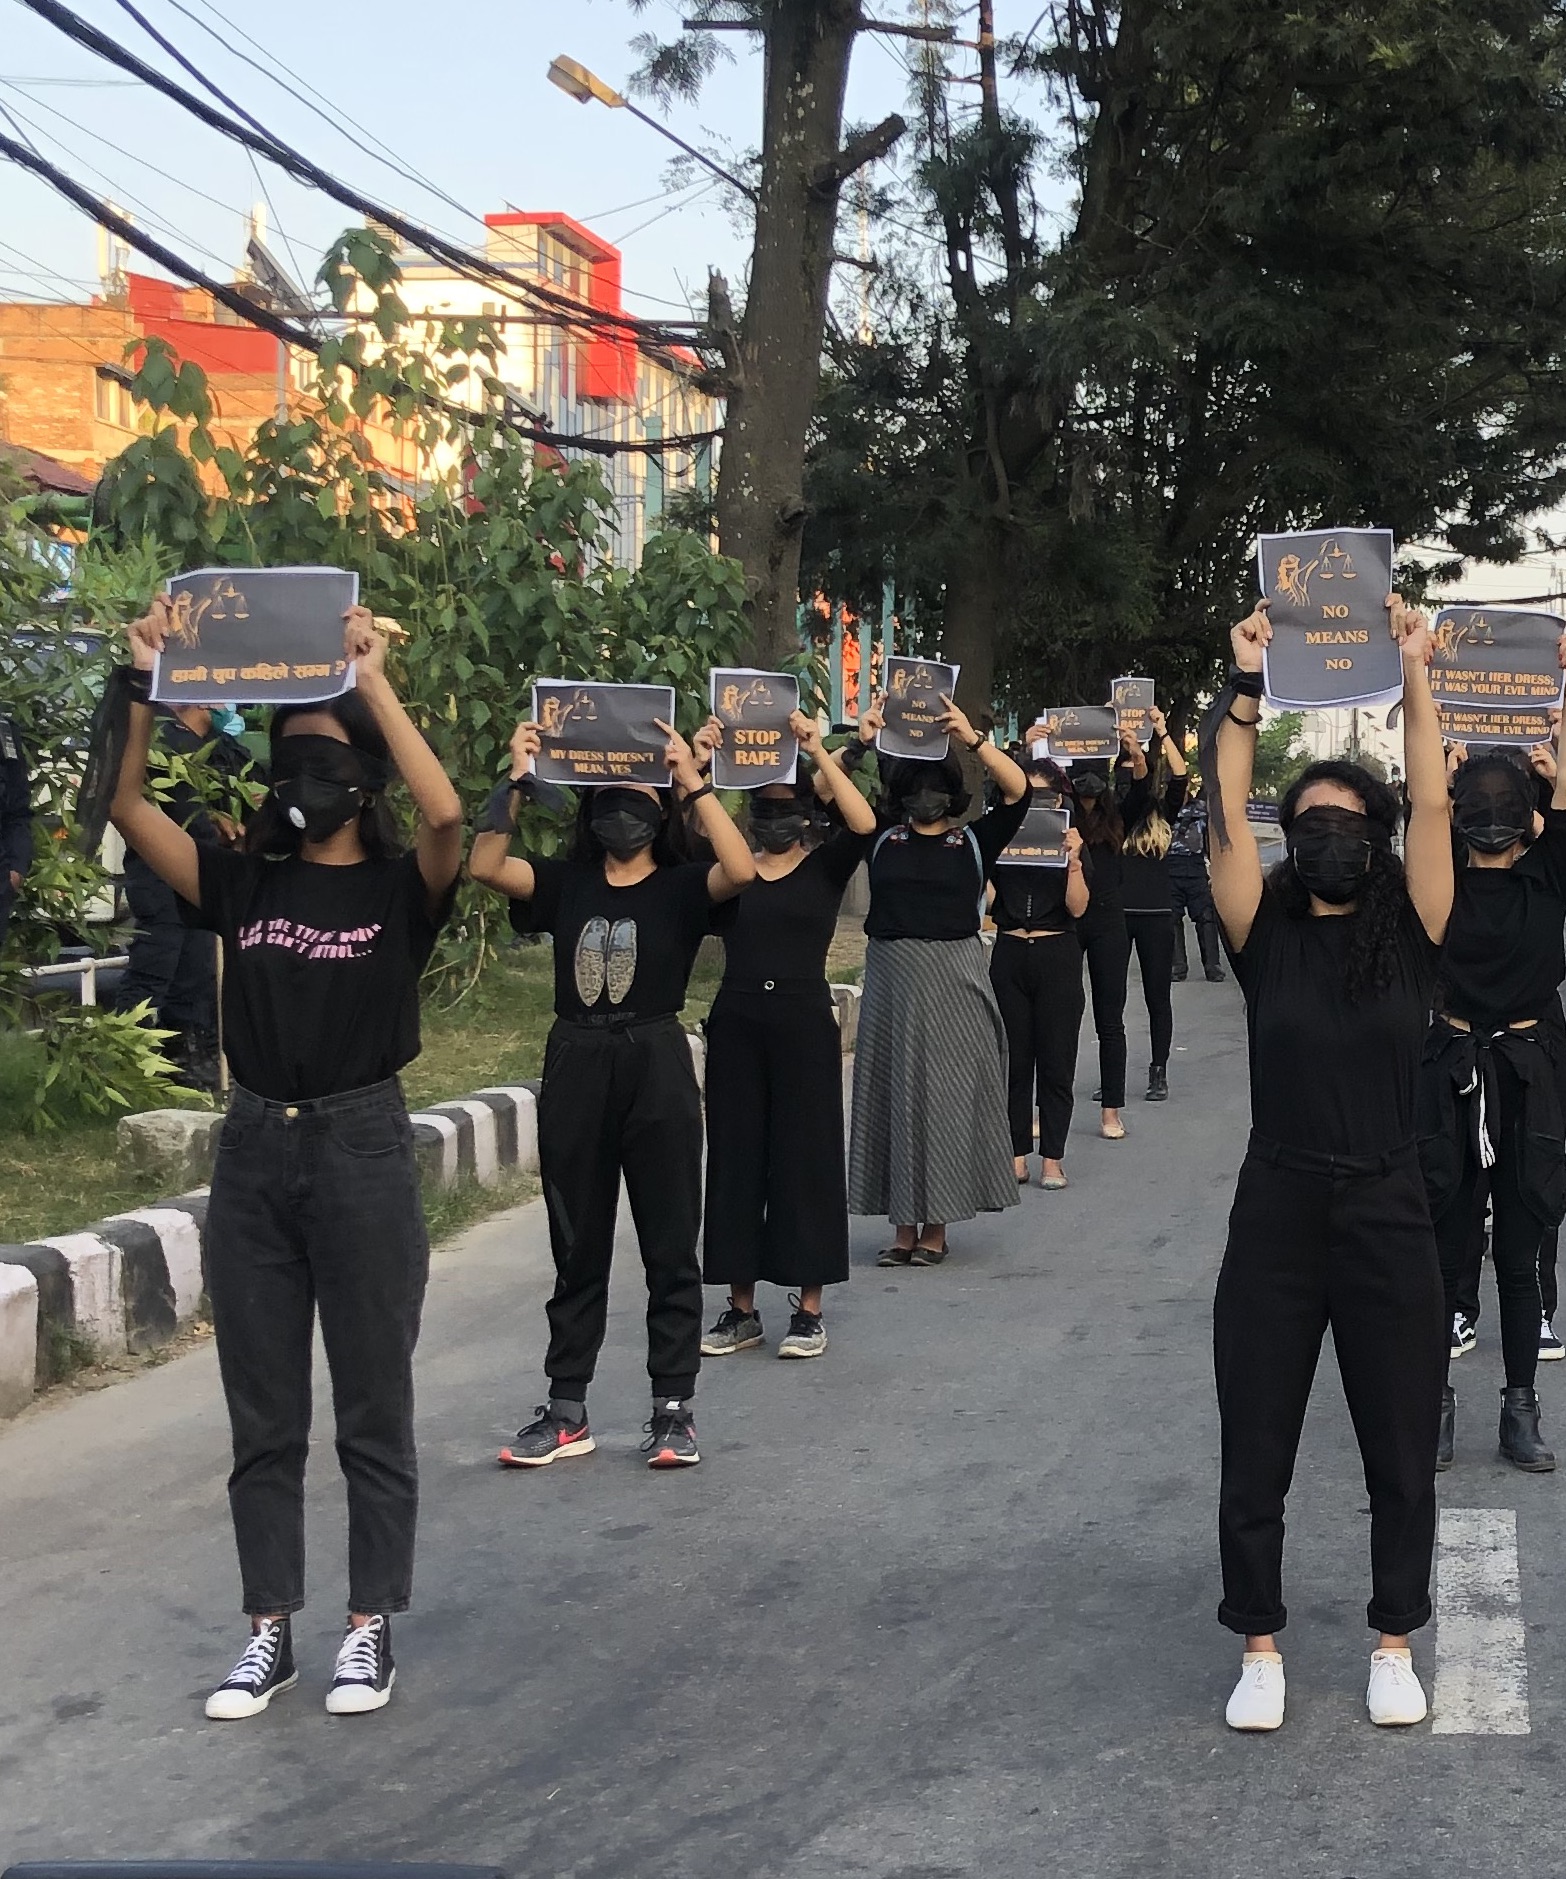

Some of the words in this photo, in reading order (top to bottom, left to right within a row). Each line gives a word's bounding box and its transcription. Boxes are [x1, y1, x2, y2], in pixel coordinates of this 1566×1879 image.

[1321, 605, 1349, 619] NO
[1305, 630, 1369, 644] MEANS
[1325, 658, 1353, 670] NO
[1431, 669, 1443, 680] IT
[1445, 669, 1486, 681] WASN'T
[1488, 671, 1511, 683] HER
[1430, 680, 1442, 691] IT
[1444, 681, 1469, 693] WAS
[1471, 684, 1502, 694] YOUR
[1504, 684, 1528, 696] EVIL
[1530, 686, 1560, 696] MIND
[911, 700, 927, 709] NO
[901, 712, 935, 723] MEANS
[1120, 708, 1146, 718] STOP
[1441, 712, 1452, 721] IT
[1453, 712, 1488, 723] WASN'T
[1490, 714, 1510, 724] HER
[909, 729, 924, 738] NO
[1452, 723, 1473, 733] WAS
[1475, 724, 1501, 734] YOUR
[1503, 725, 1524, 735] EVIL
[1525, 726, 1550, 735] MIND
[734, 729, 782, 745] STOP
[550, 749, 567, 760] MY
[569, 750, 604, 762] DRESS
[607, 751, 654, 763] DOESN'T
[735, 750, 781, 766] RAPE
[268, 918, 292, 932] THE
